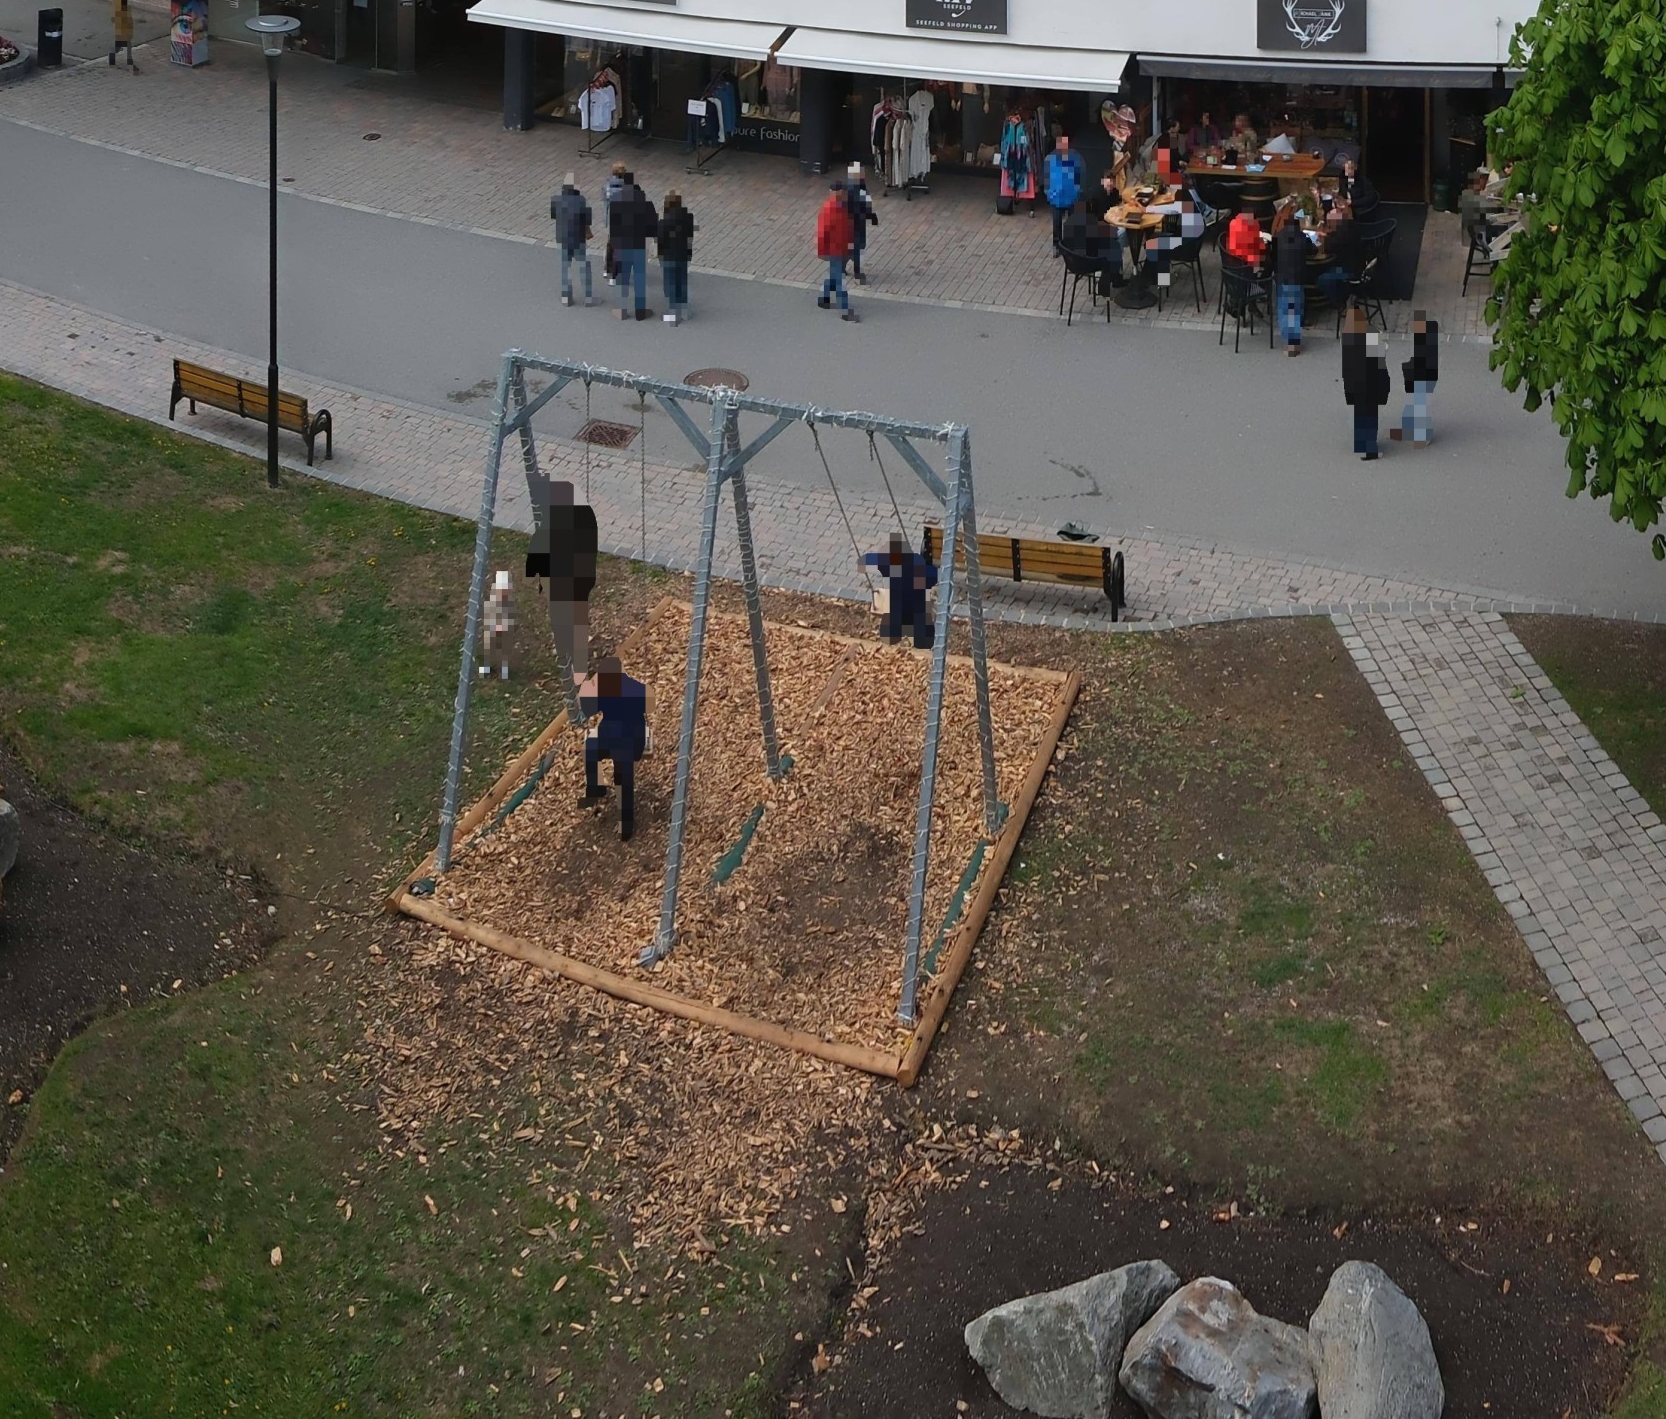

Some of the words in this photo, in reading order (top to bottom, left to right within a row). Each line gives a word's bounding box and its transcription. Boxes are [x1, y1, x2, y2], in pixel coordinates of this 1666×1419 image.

[942, 3, 972, 11] SEEFELD
[916, 19, 945, 27] SEEFELD
[946, 21, 982, 30] SHOPPING
[731, 125, 757, 139] pure
